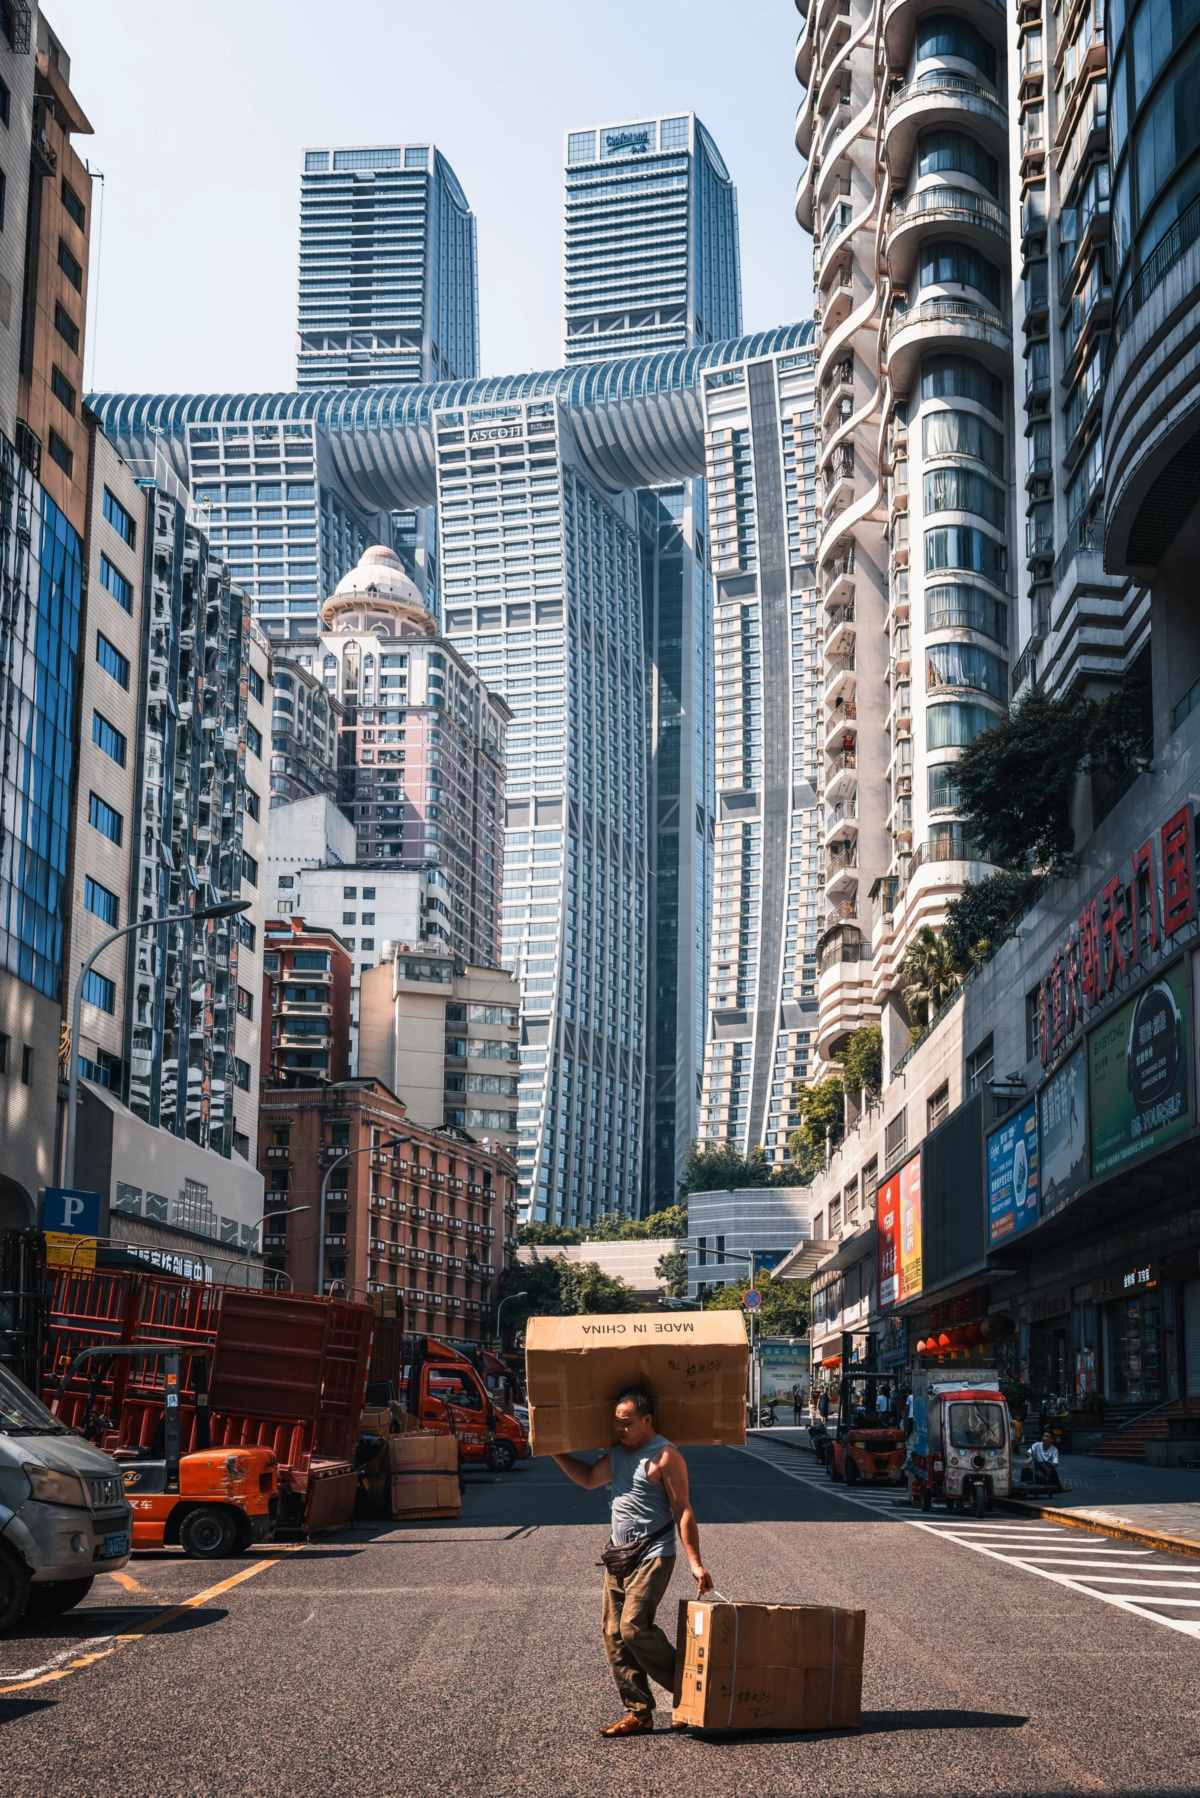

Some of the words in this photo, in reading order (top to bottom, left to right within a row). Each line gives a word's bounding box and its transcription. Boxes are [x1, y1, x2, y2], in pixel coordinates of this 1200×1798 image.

[62, 1196, 85, 1227] P
[582, 1324, 626, 1335] CHINA
[633, 1323, 647, 1333] IN
[654, 1322, 694, 1333] MADE
